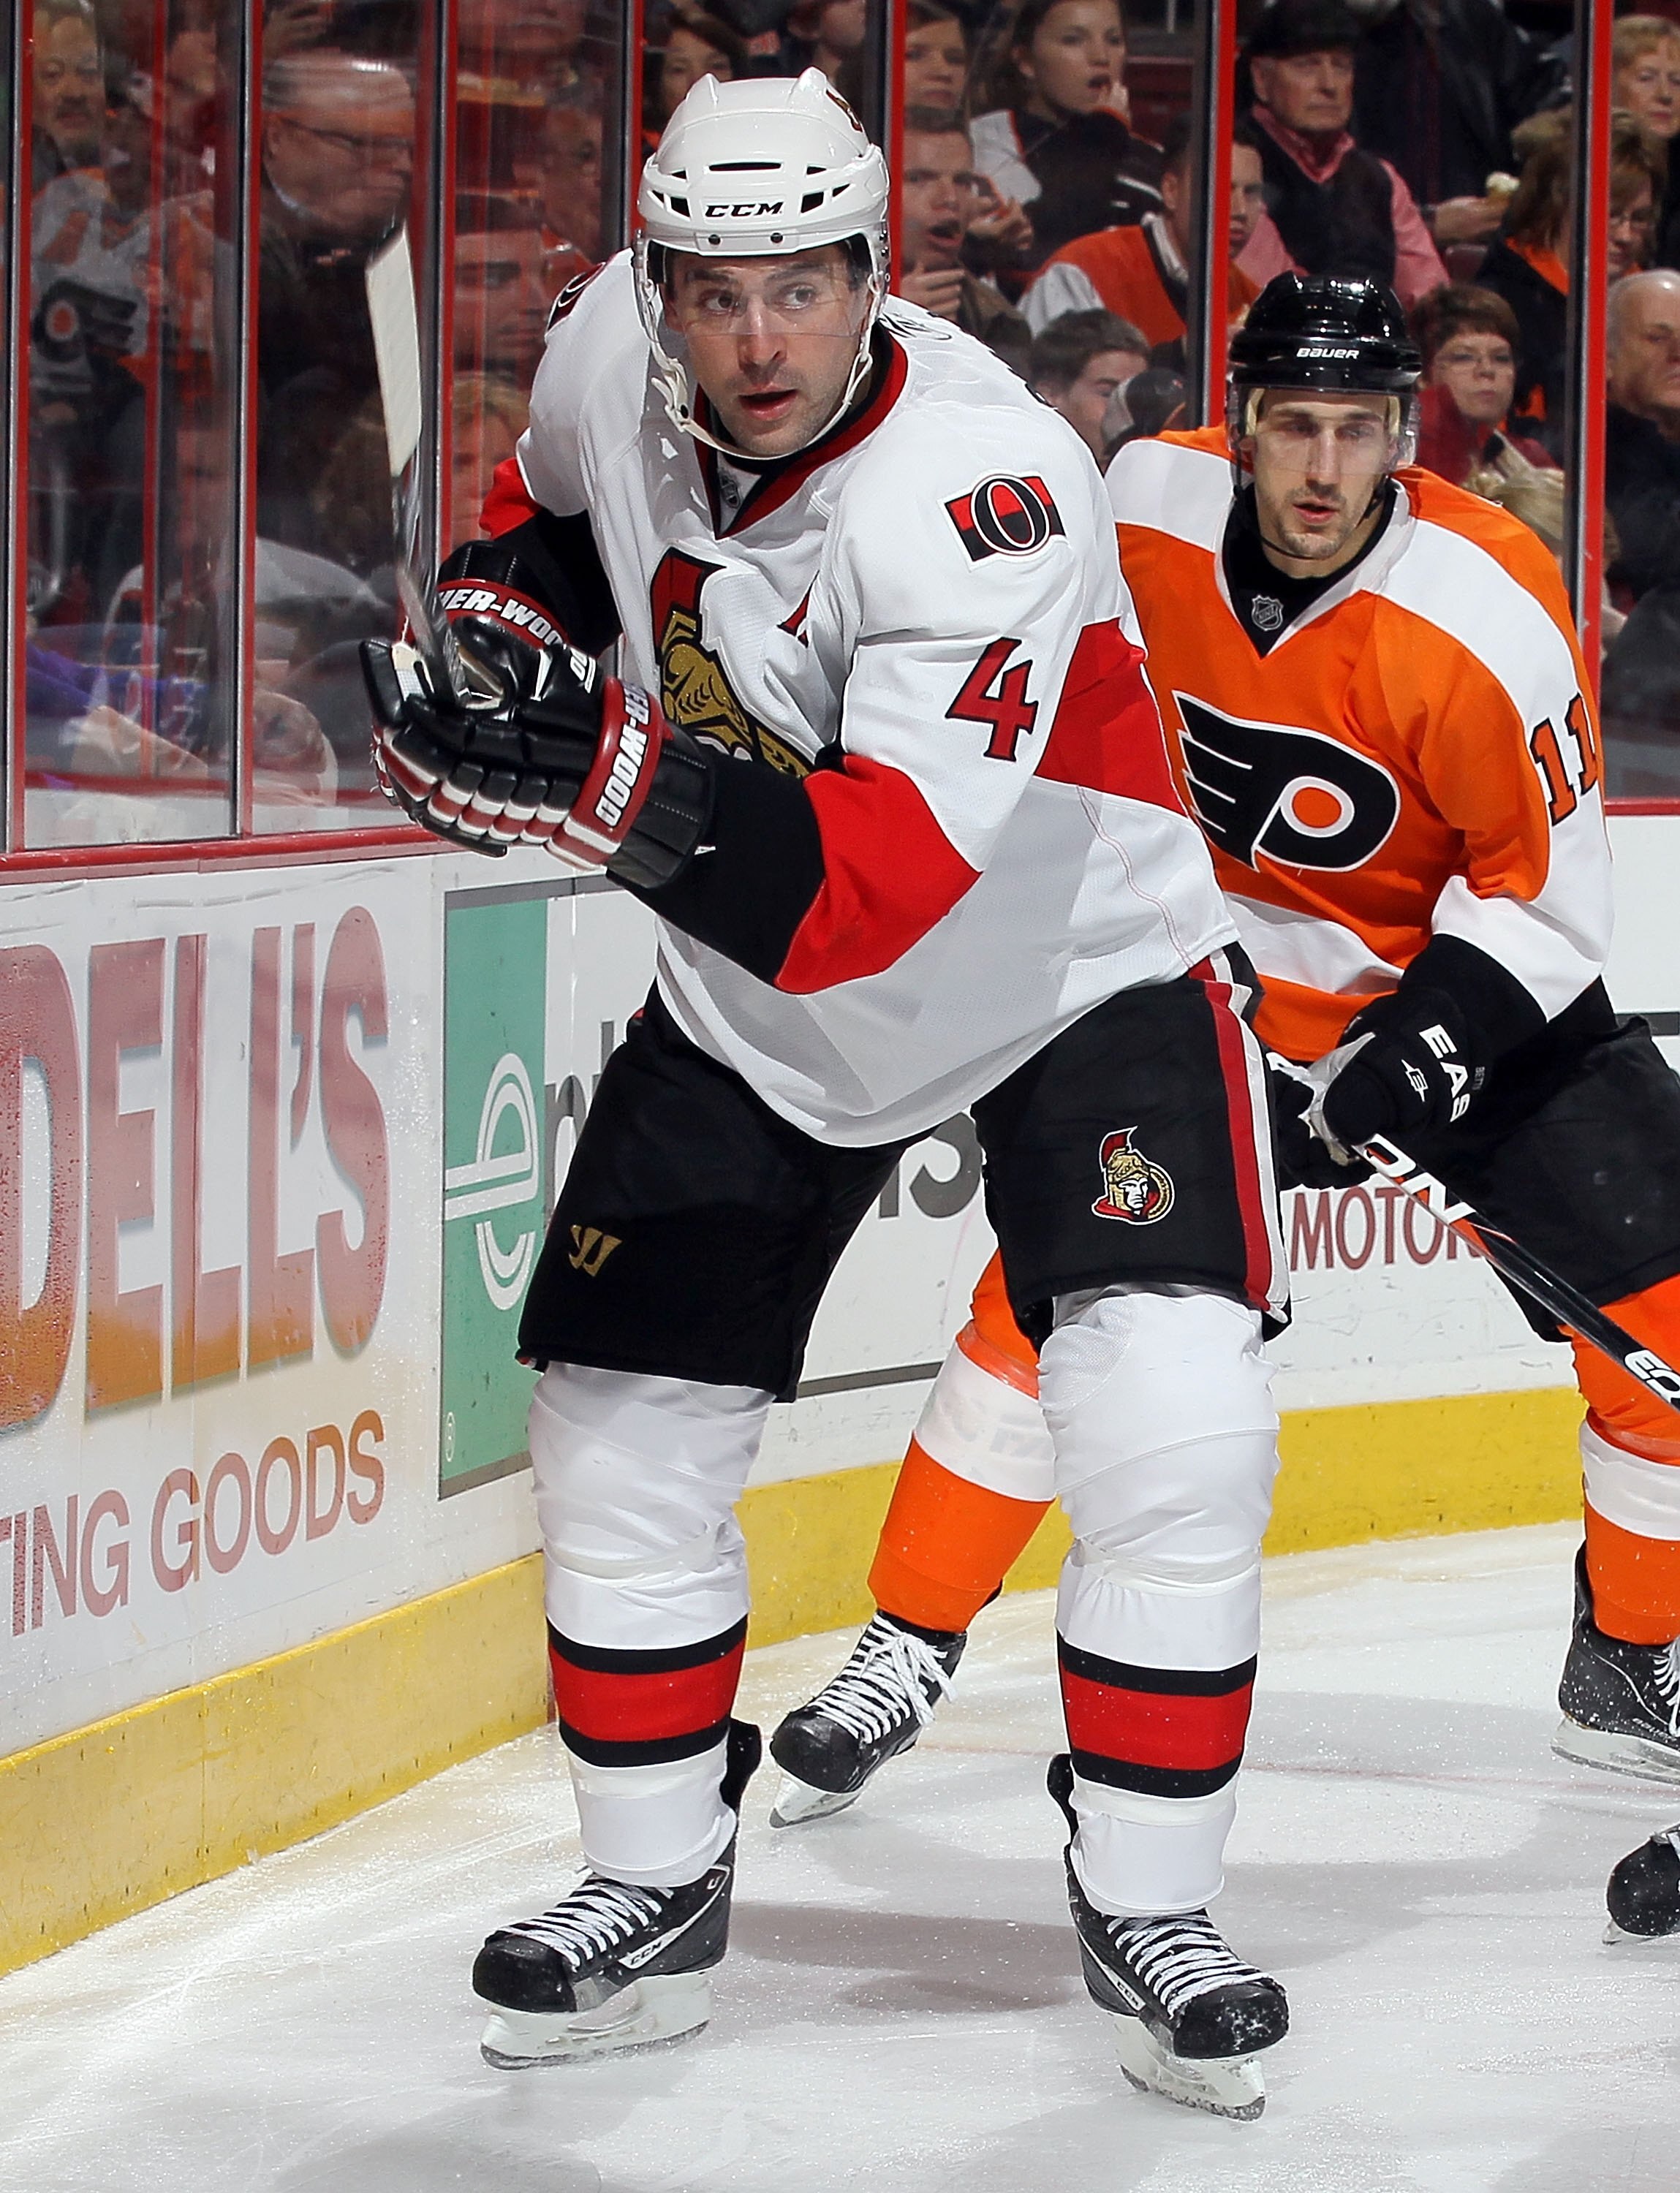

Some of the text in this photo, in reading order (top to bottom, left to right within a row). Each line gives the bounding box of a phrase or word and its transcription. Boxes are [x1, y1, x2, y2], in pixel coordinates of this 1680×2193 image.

[705, 201, 784, 217] CCM
[945, 636, 1039, 762] 4
[1529, 692, 1598, 827] 11
[151, 1409, 385, 1592] GOODS
